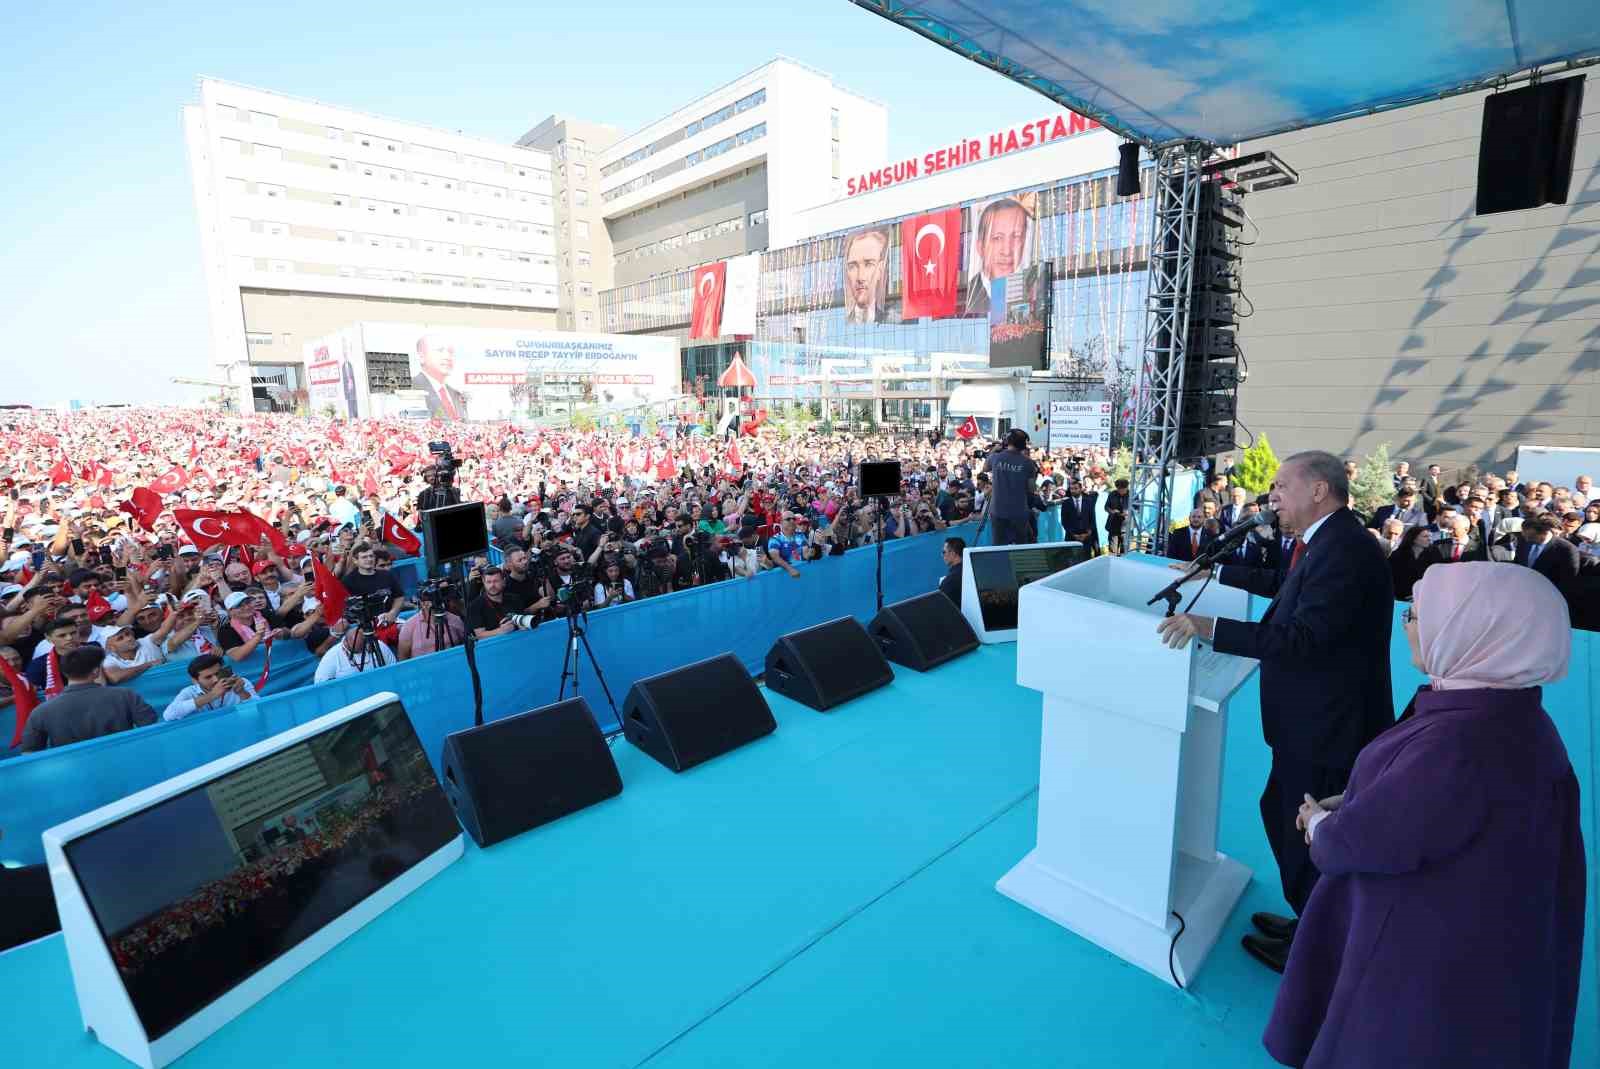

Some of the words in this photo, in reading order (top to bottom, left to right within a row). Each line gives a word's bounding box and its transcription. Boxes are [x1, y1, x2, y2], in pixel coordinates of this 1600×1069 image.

[847, 158, 918, 196] SAMSUN
[924, 138, 981, 175] ŞEHİR
[484, 348, 517, 359] SAYIN
[518, 350, 550, 360] RECEP
